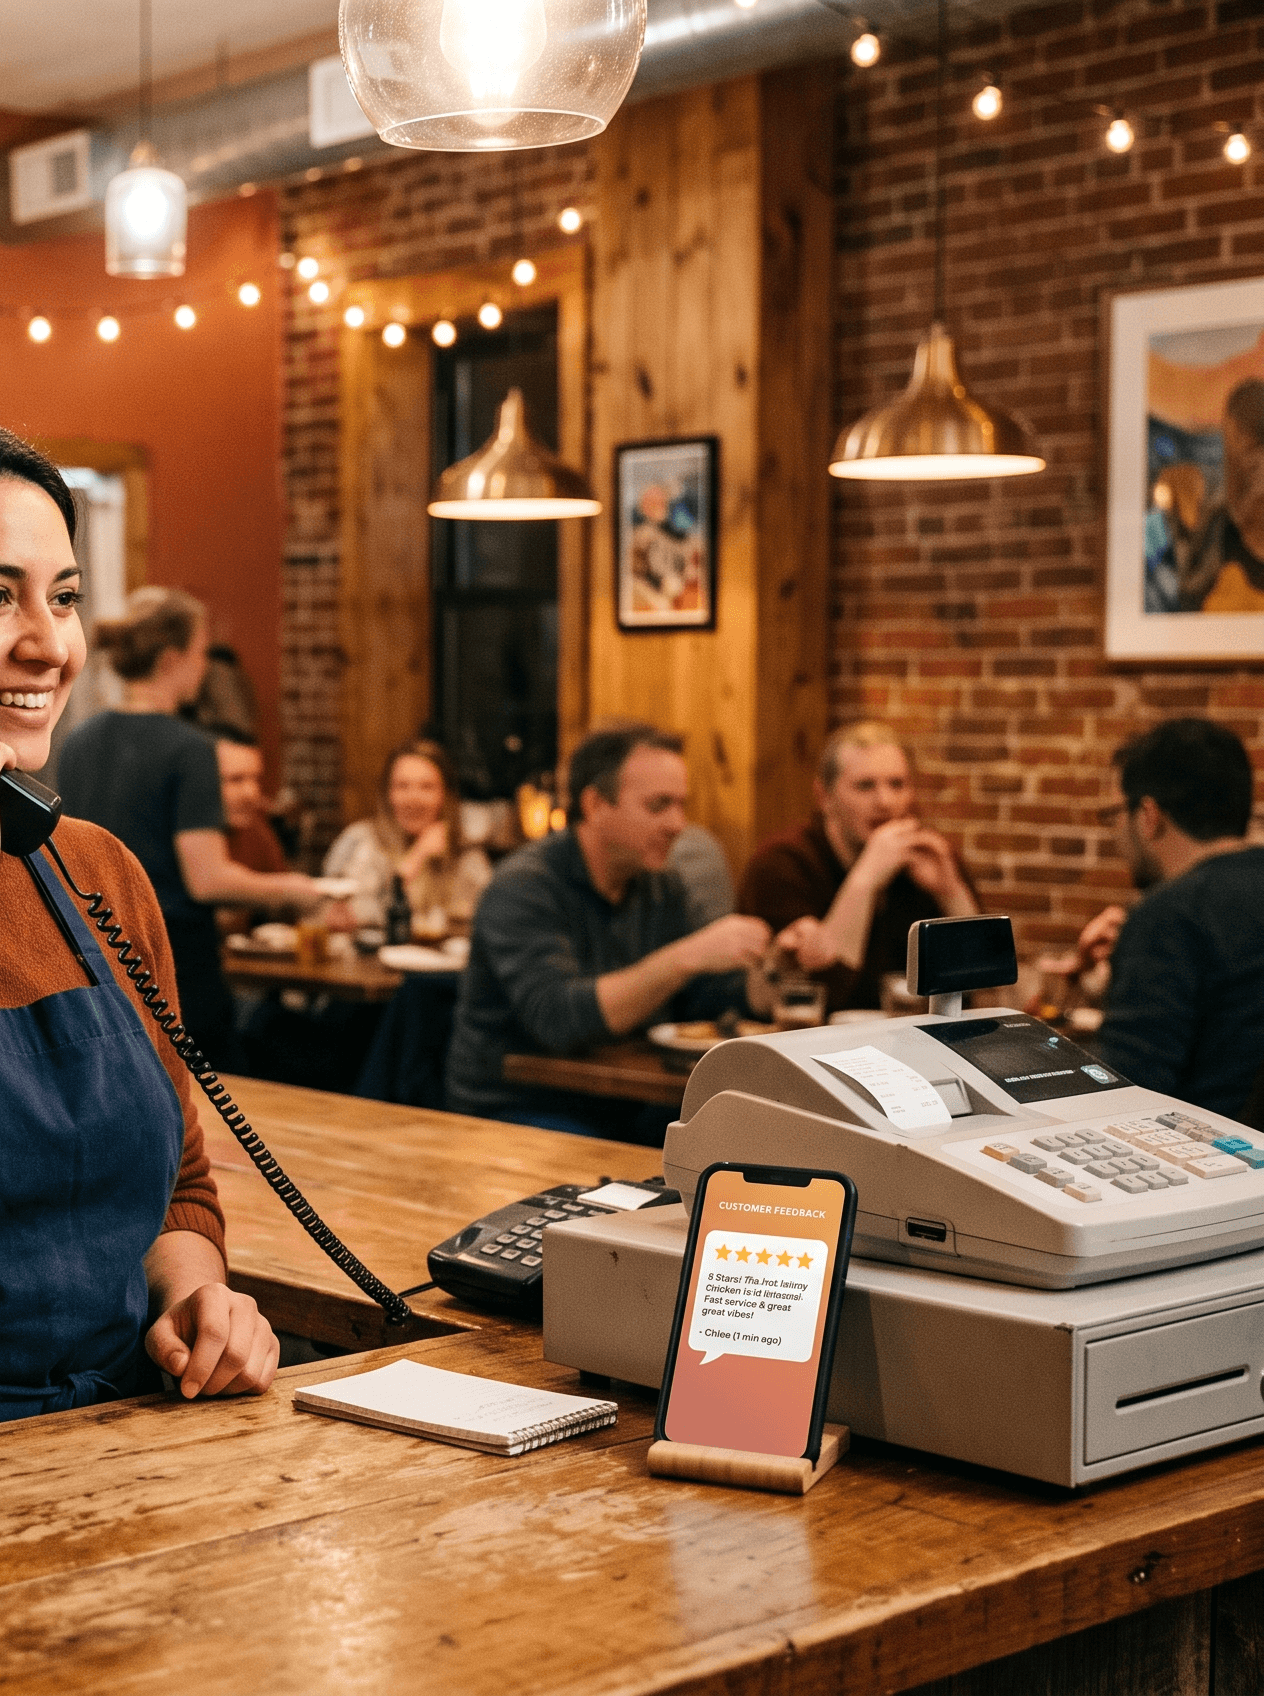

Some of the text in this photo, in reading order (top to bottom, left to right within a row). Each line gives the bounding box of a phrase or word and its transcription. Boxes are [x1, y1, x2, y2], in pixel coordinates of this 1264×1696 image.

[719, 1201, 826, 1218] CUSTOMER FEEDBACK
[715, 1273, 743, 1284] Stars!
[703, 1294, 792, 1312] Fast service & great
[701, 1307, 755, 1319] great vibes!
[732, 1331, 740, 1342] (1
[742, 1333, 759, 1343] min
[761, 1336, 782, 1346] ago)
